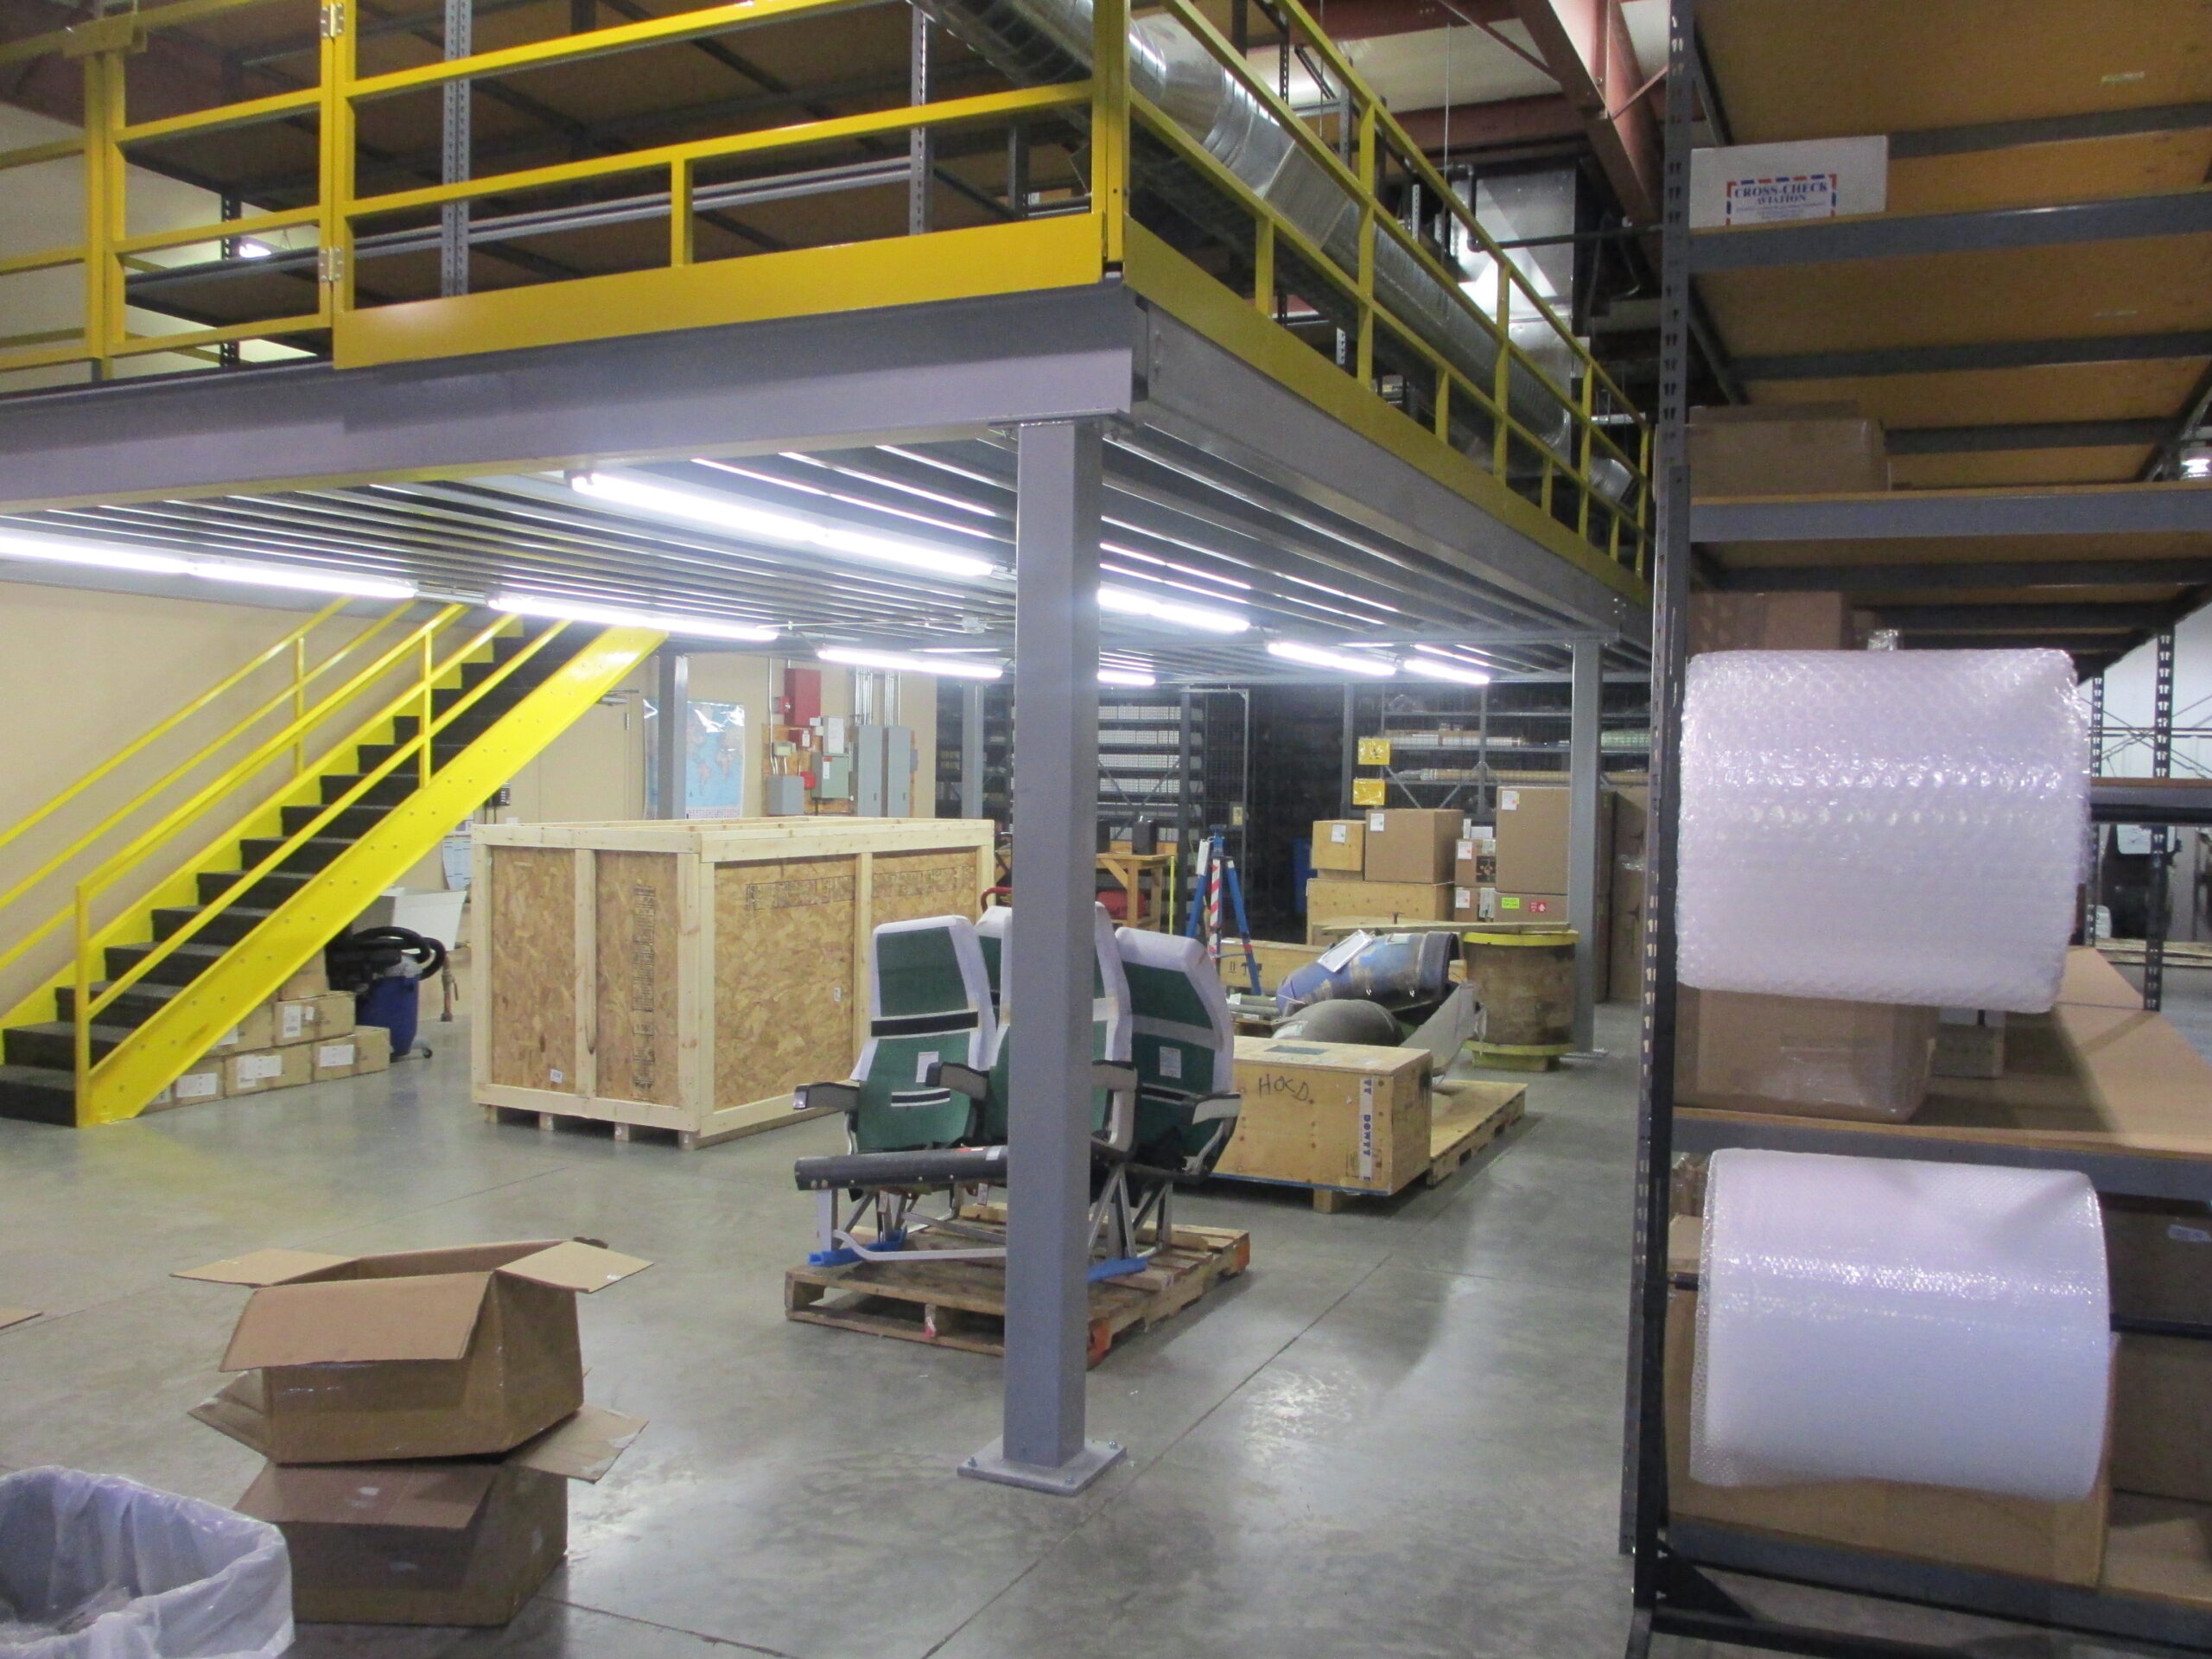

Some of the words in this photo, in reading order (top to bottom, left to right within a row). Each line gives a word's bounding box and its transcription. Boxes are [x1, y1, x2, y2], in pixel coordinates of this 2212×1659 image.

[1734, 182, 1827, 198] CROSS-CHECK
[1756, 194, 1807, 205] AVIATION
[1363, 1114, 1372, 1157] DOWTY
